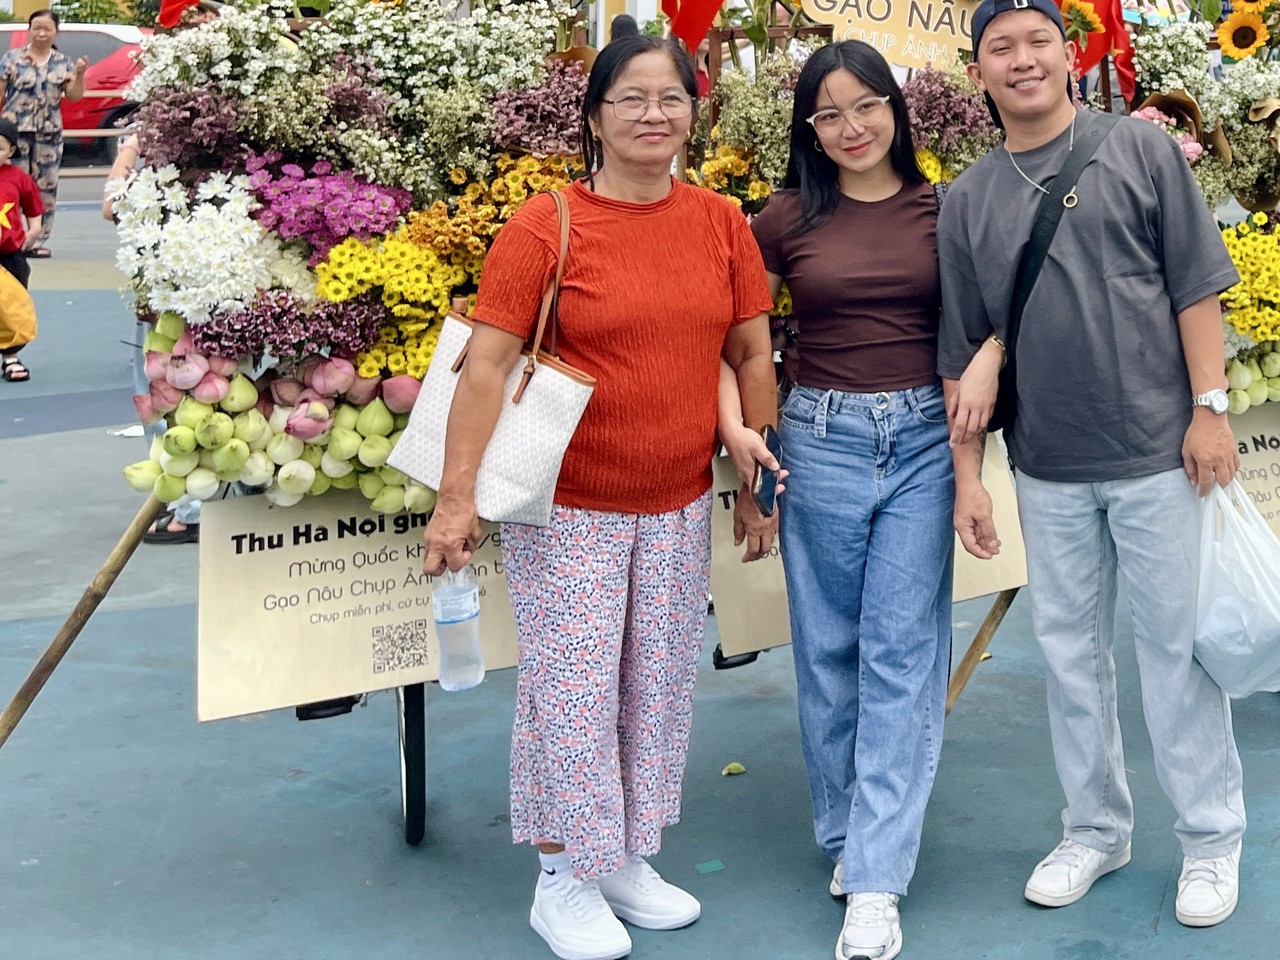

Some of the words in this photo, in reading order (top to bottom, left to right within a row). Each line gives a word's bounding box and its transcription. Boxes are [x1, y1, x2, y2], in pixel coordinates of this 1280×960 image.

[231, 533, 284, 555] Thu
[352, 545, 399, 569] Quốc
[263, 594, 300, 612] Gạo
[350, 577, 396, 596] Chụp
[309, 612, 340, 624] Chụp
